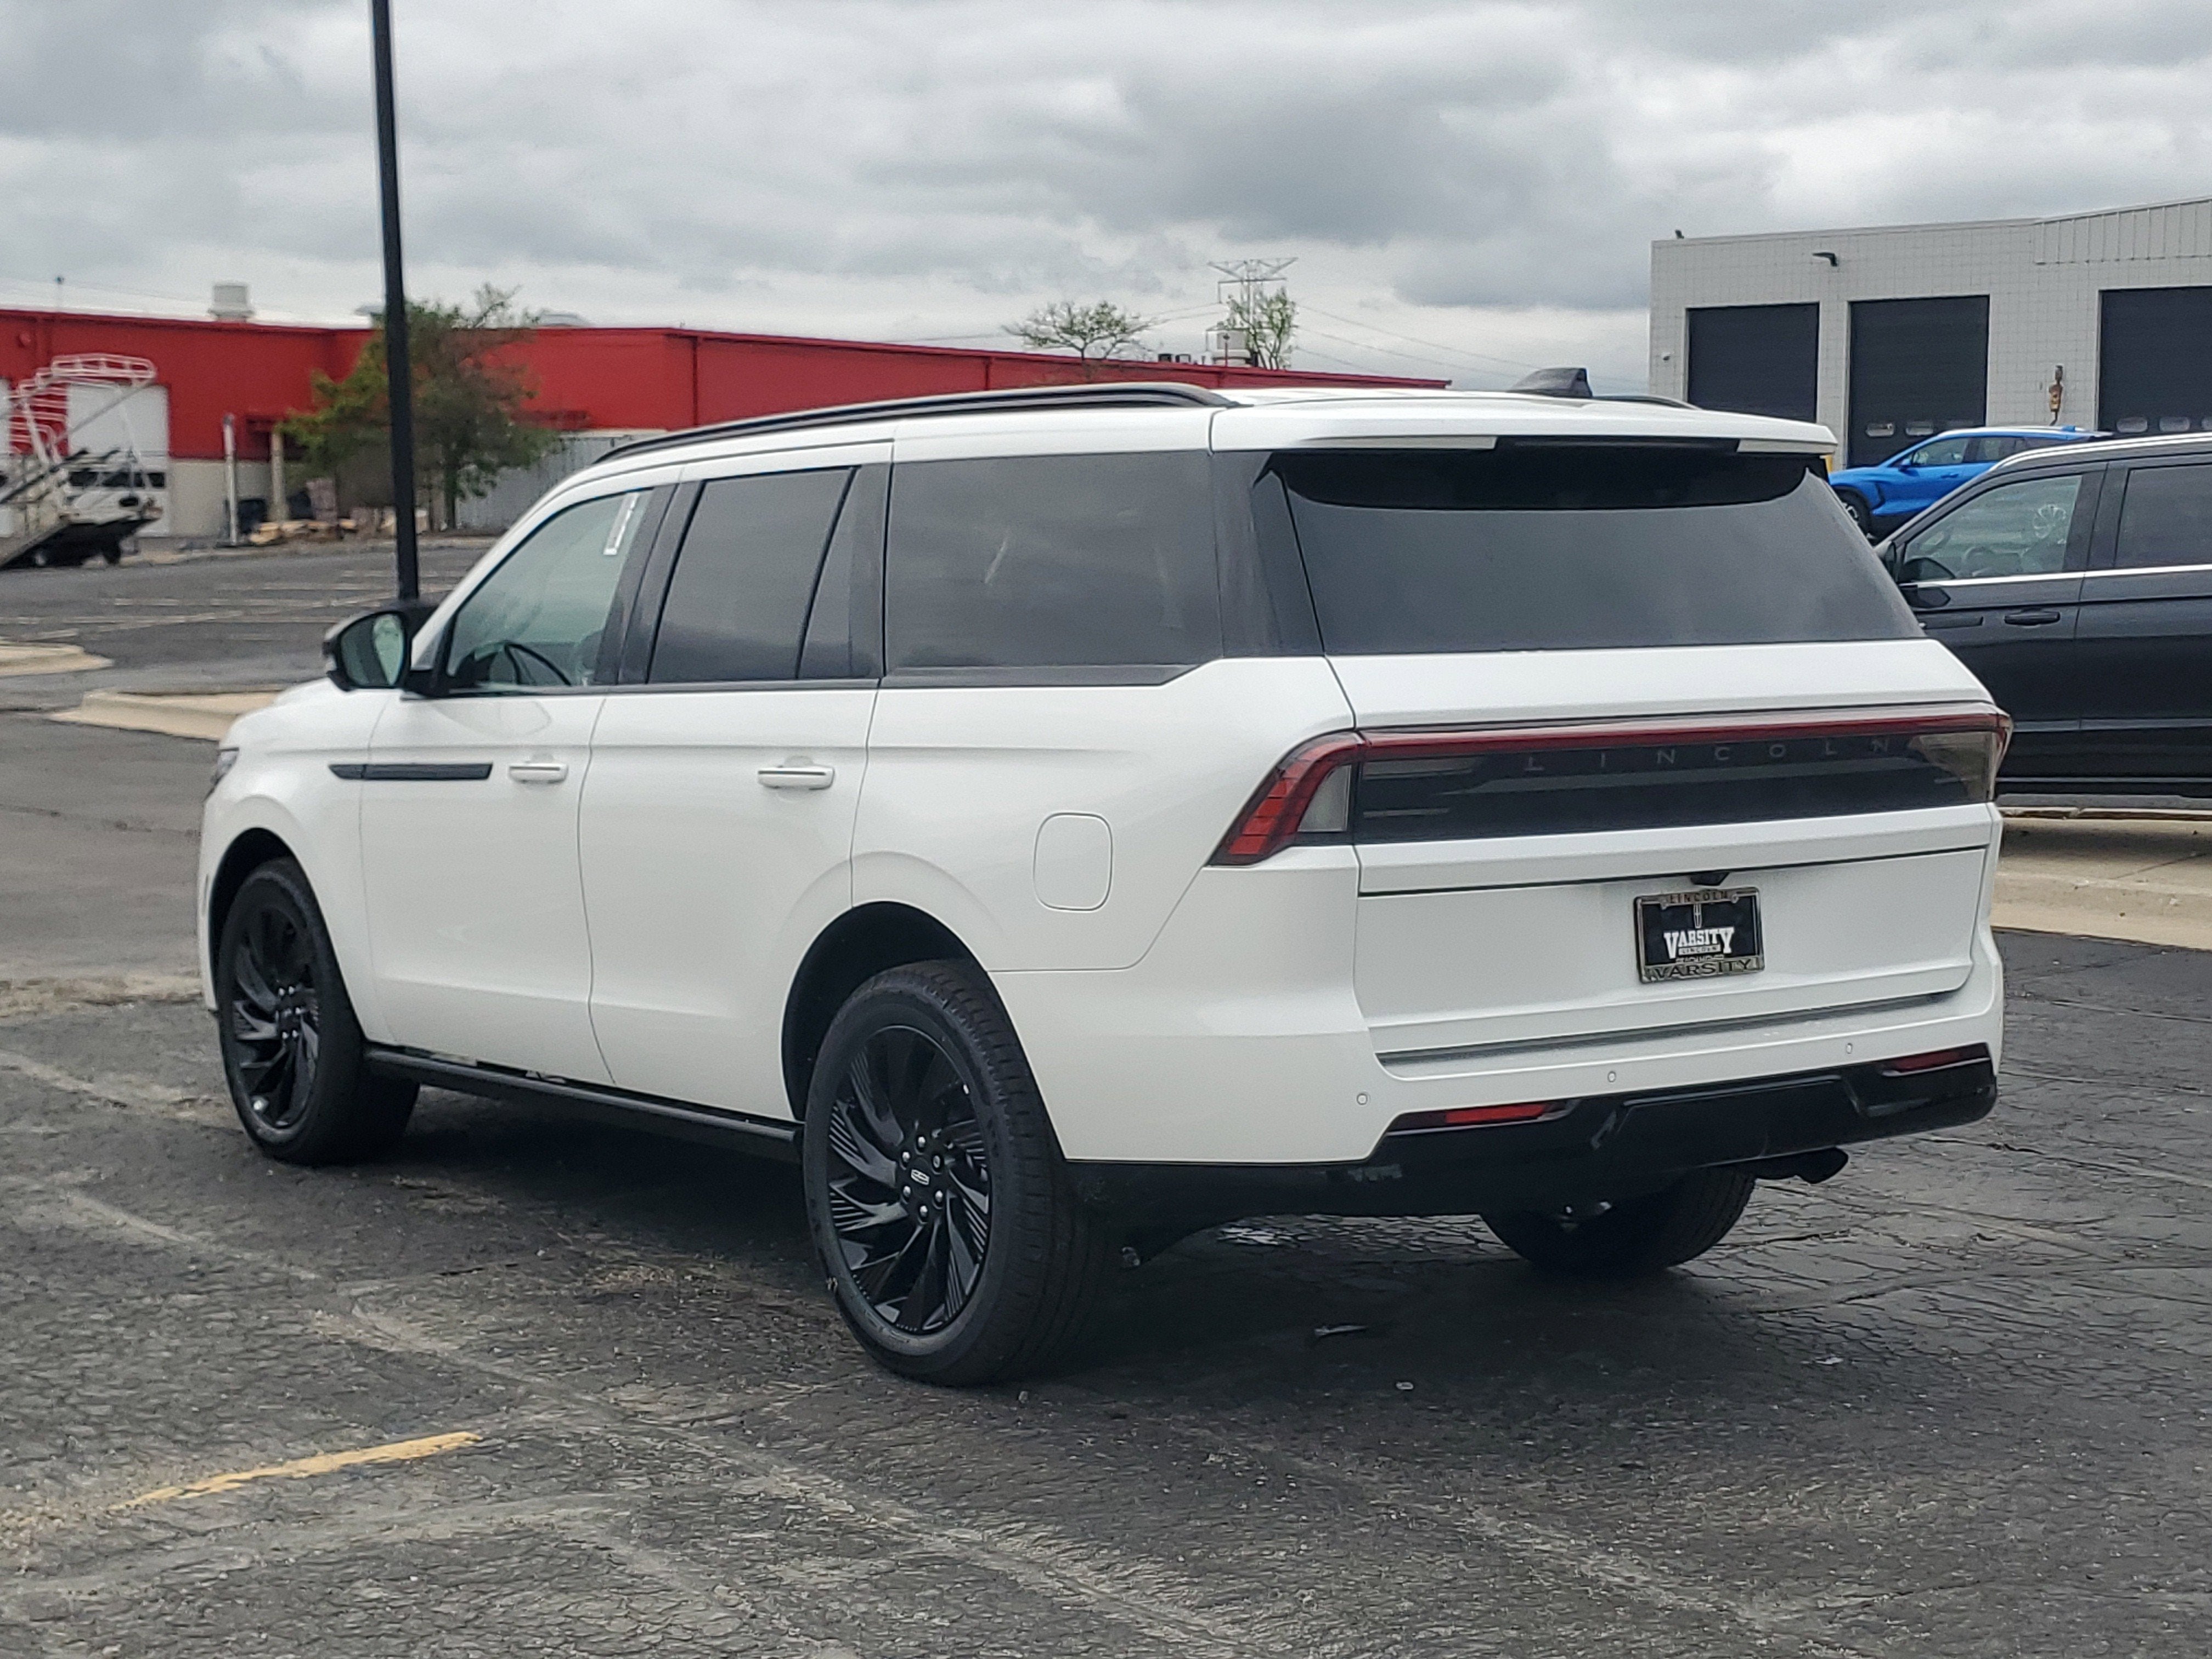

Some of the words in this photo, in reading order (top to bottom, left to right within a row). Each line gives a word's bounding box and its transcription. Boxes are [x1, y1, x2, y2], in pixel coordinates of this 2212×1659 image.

[1523, 738, 1888, 771] LINCOLN
[1670, 890, 1728, 904] LINCOLN
[1663, 926, 1735, 960] VARSITY
[1654, 958, 1752, 979] VARSITY
